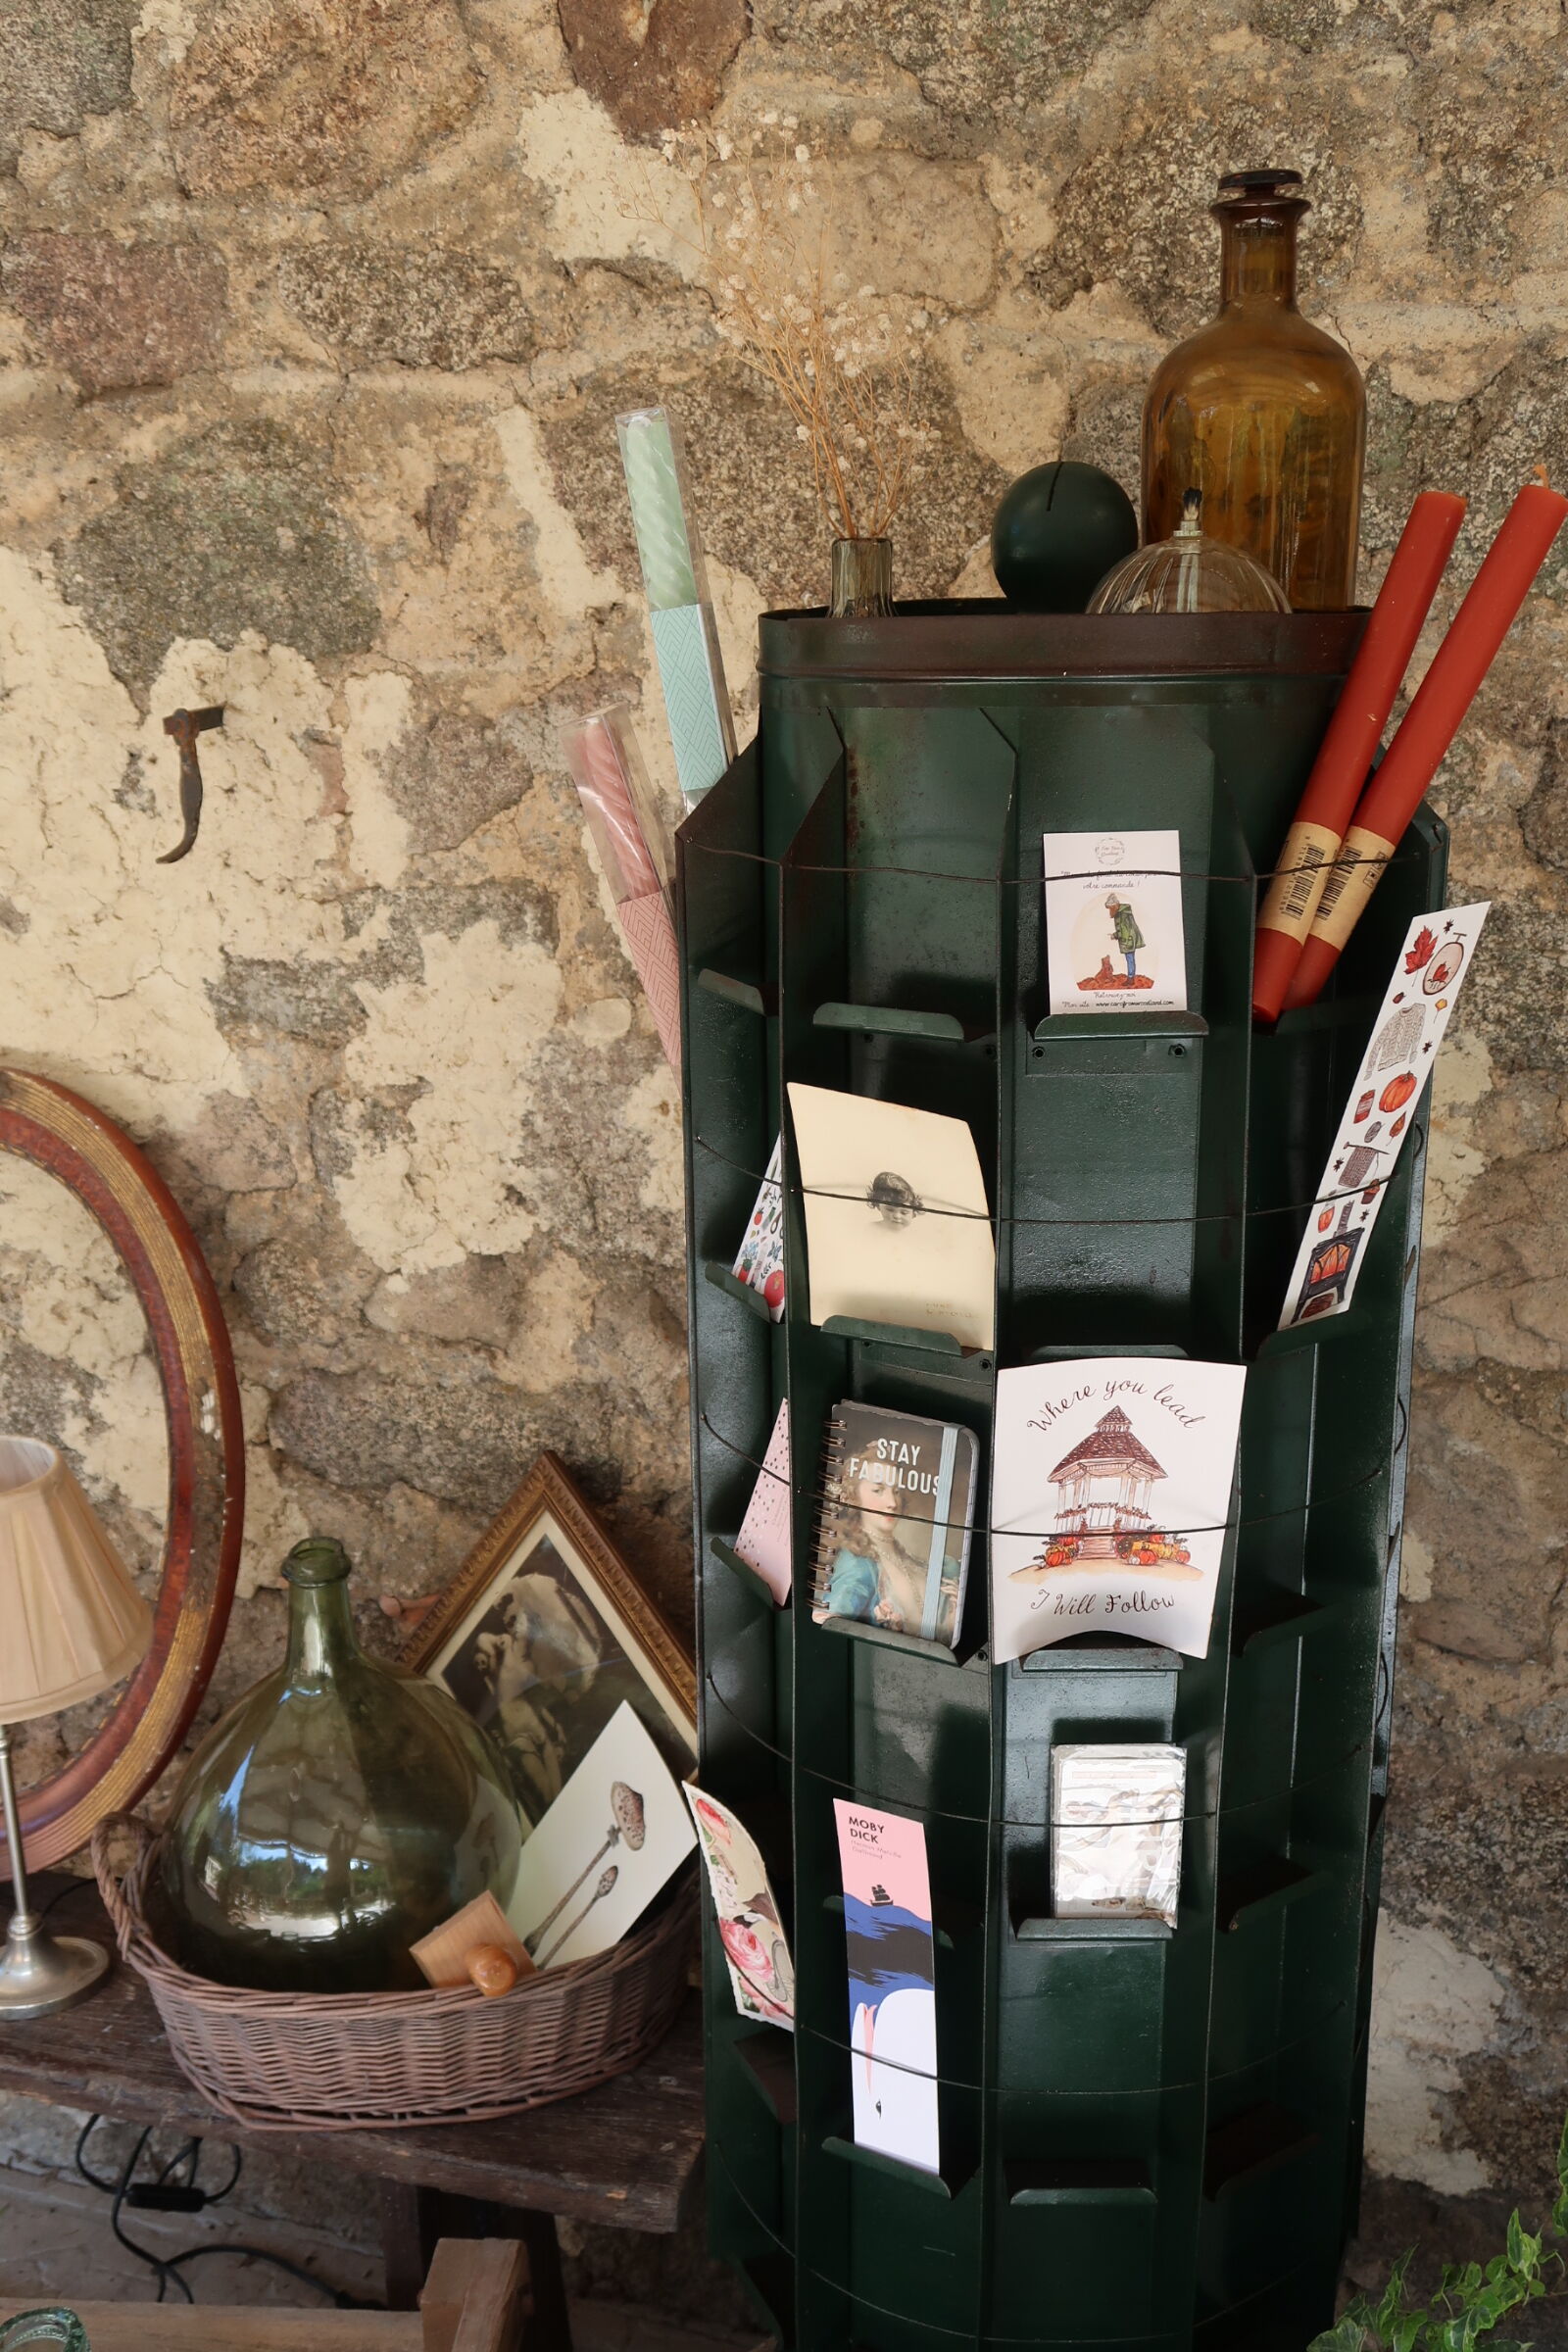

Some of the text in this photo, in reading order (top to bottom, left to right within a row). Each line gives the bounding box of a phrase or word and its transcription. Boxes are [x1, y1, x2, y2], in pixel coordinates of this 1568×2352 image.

[1027, 1379, 1205, 1431] Where you lead
[877, 1438, 920, 1465] STAY
[1054, 1593, 1096, 1615] Will
[1104, 1590, 1175, 1614] Follow
[849, 1816, 884, 1834] MOBY
[851, 1829, 878, 1843] DICK
